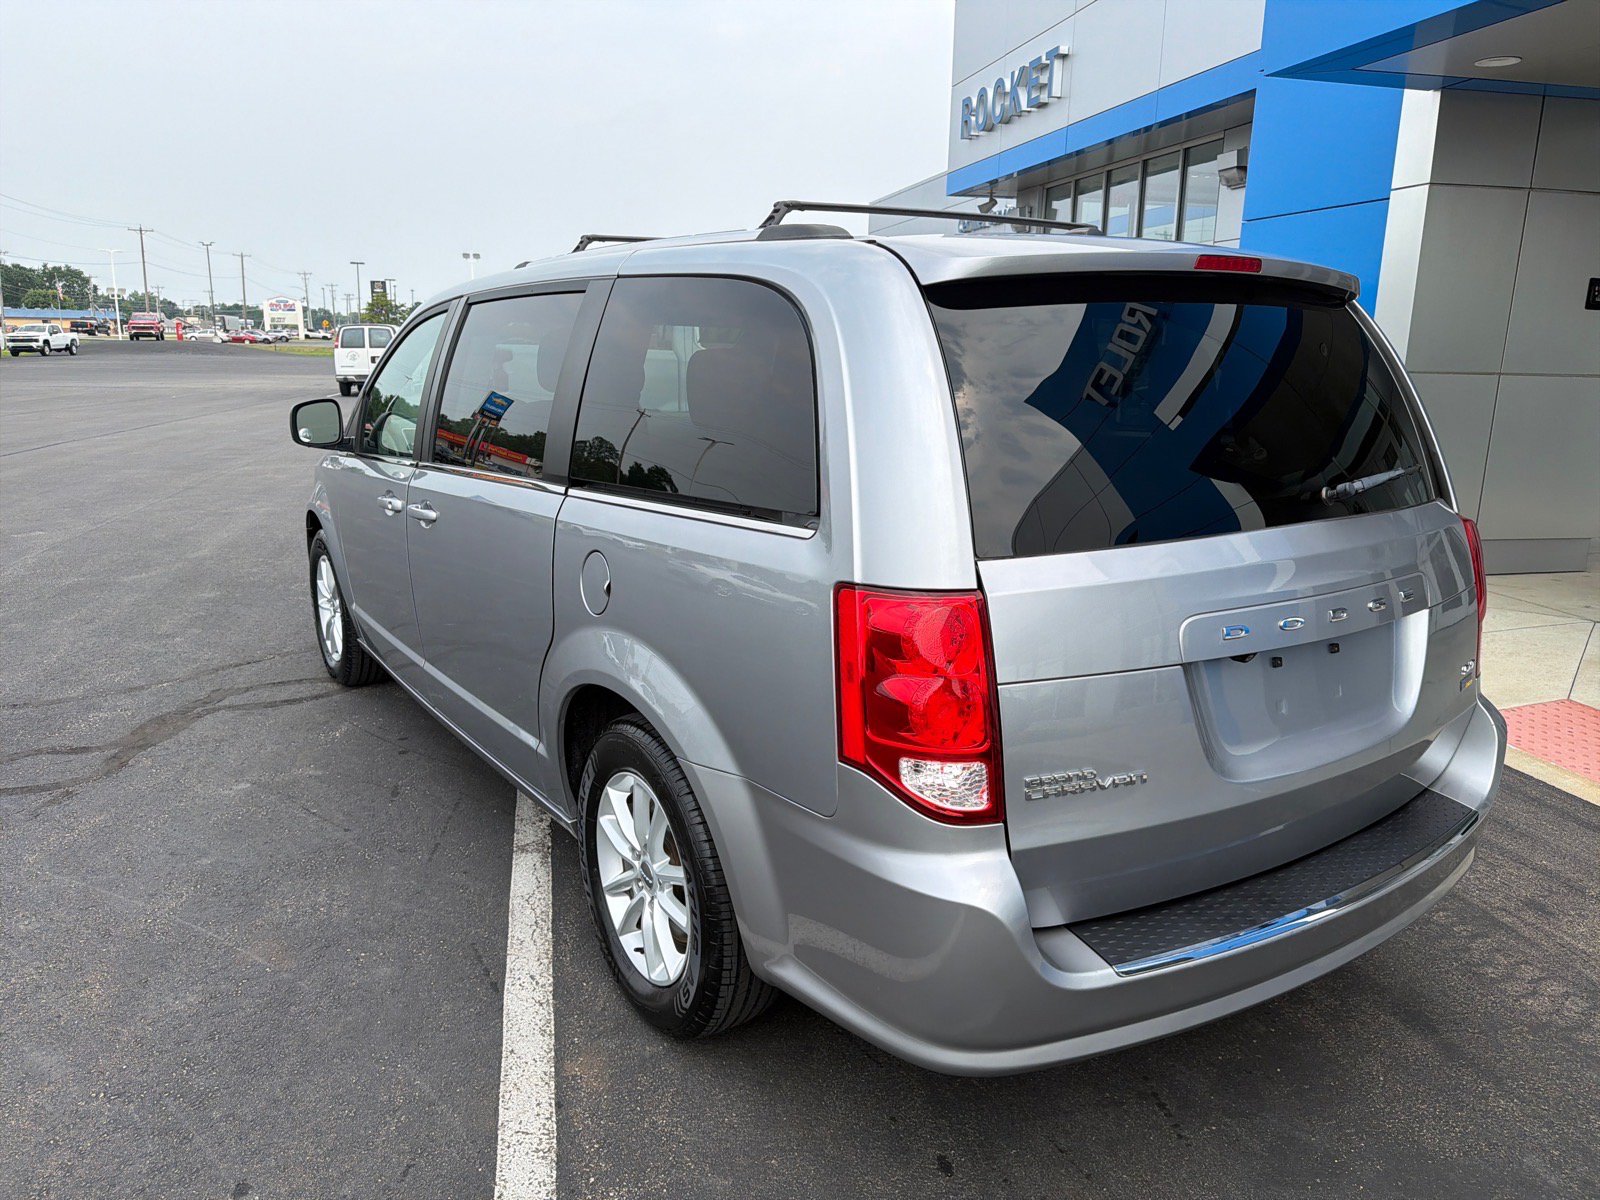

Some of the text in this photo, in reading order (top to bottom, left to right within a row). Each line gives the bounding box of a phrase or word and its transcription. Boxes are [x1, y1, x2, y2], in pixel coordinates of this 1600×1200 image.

[960, 45, 1069, 140] ROCKET
[1222, 589, 1415, 641] DODGE
[1024, 767, 1097, 788] GRAND
[1024, 770, 1148, 801] CARAVAN
